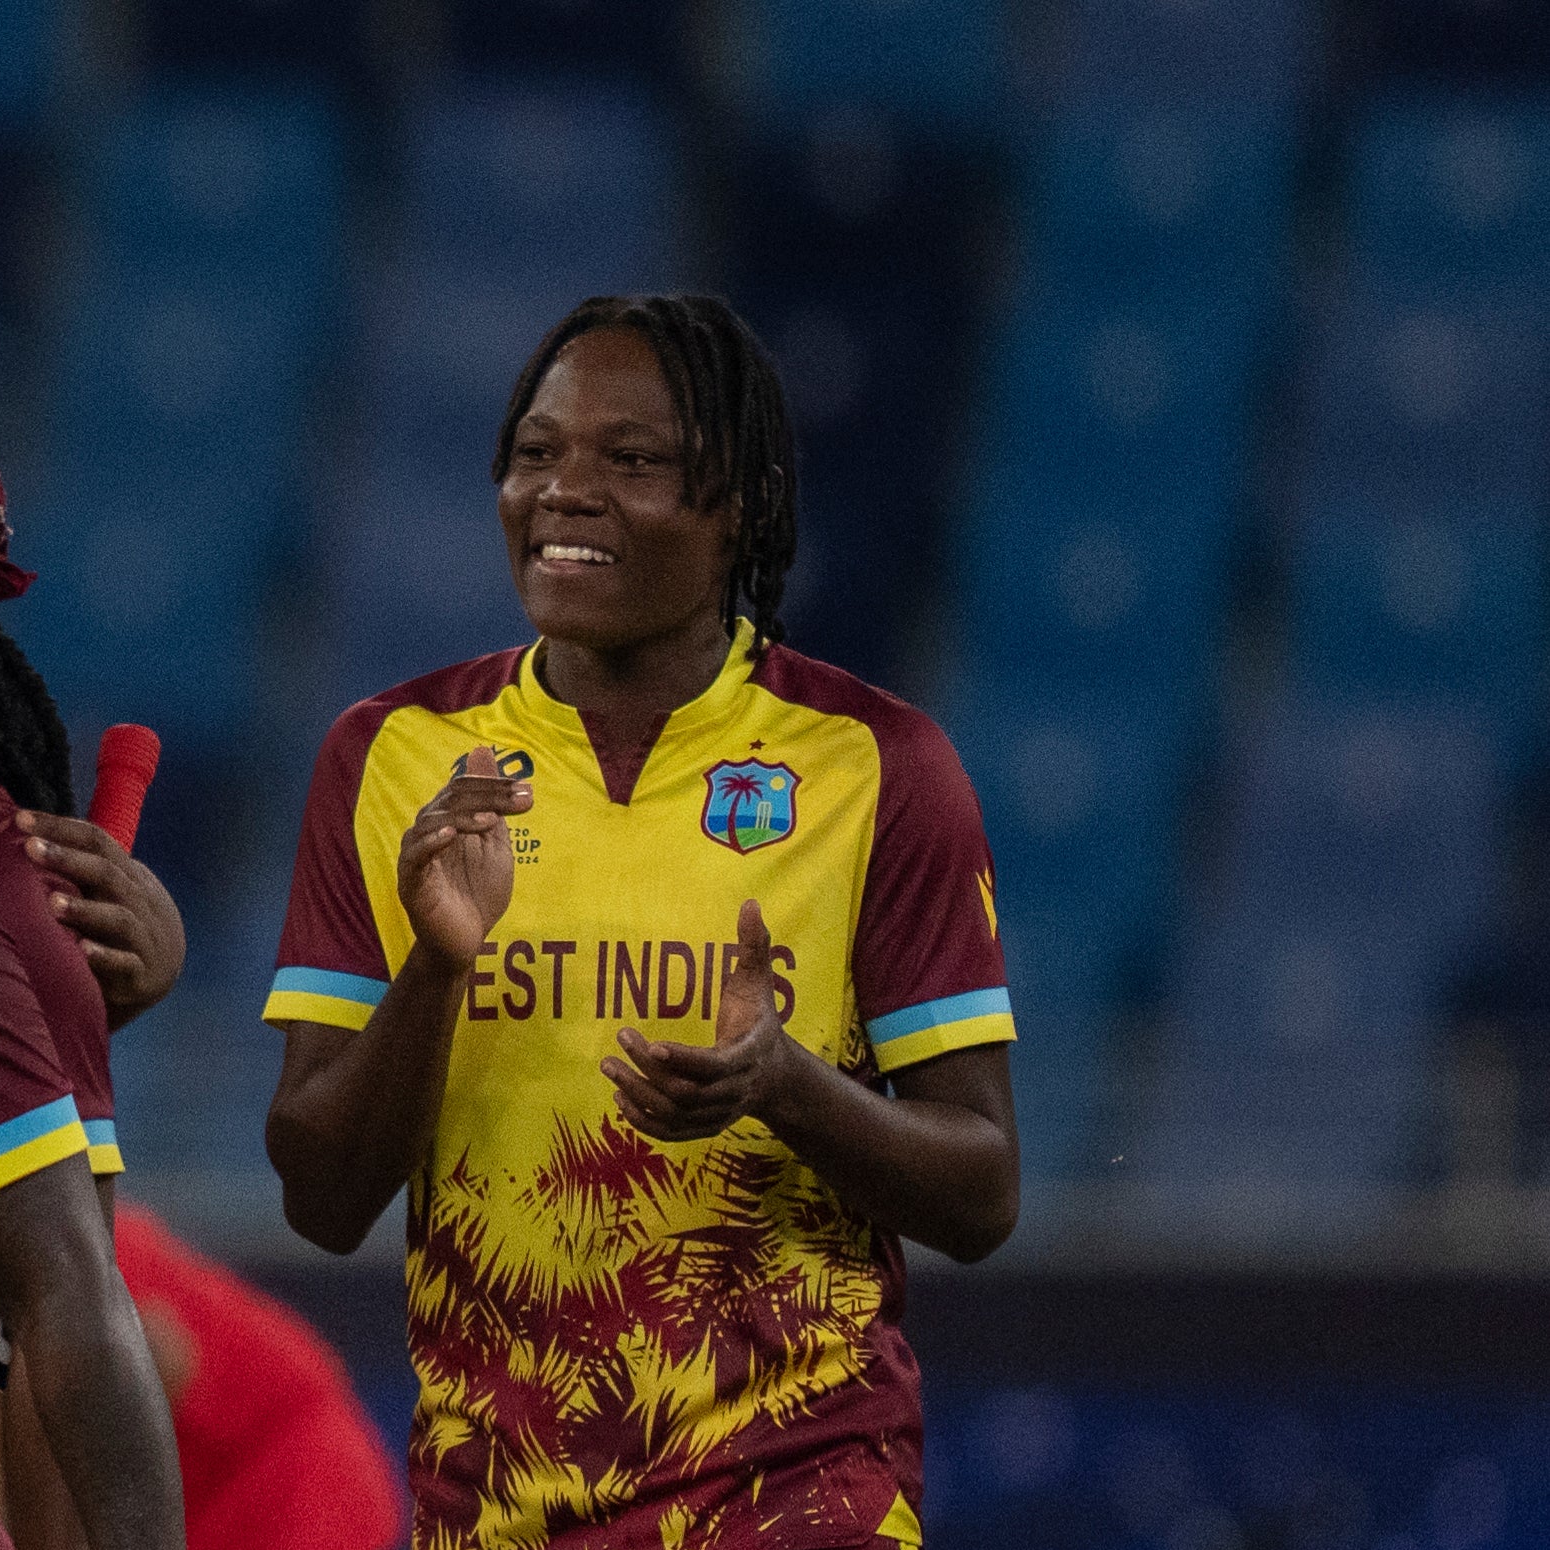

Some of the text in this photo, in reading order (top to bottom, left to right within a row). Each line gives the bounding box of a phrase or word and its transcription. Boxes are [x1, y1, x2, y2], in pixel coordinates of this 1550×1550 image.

[510, 839, 542, 854] UP
[513, 855, 540, 865] 024
[466, 940, 577, 1022] EST
